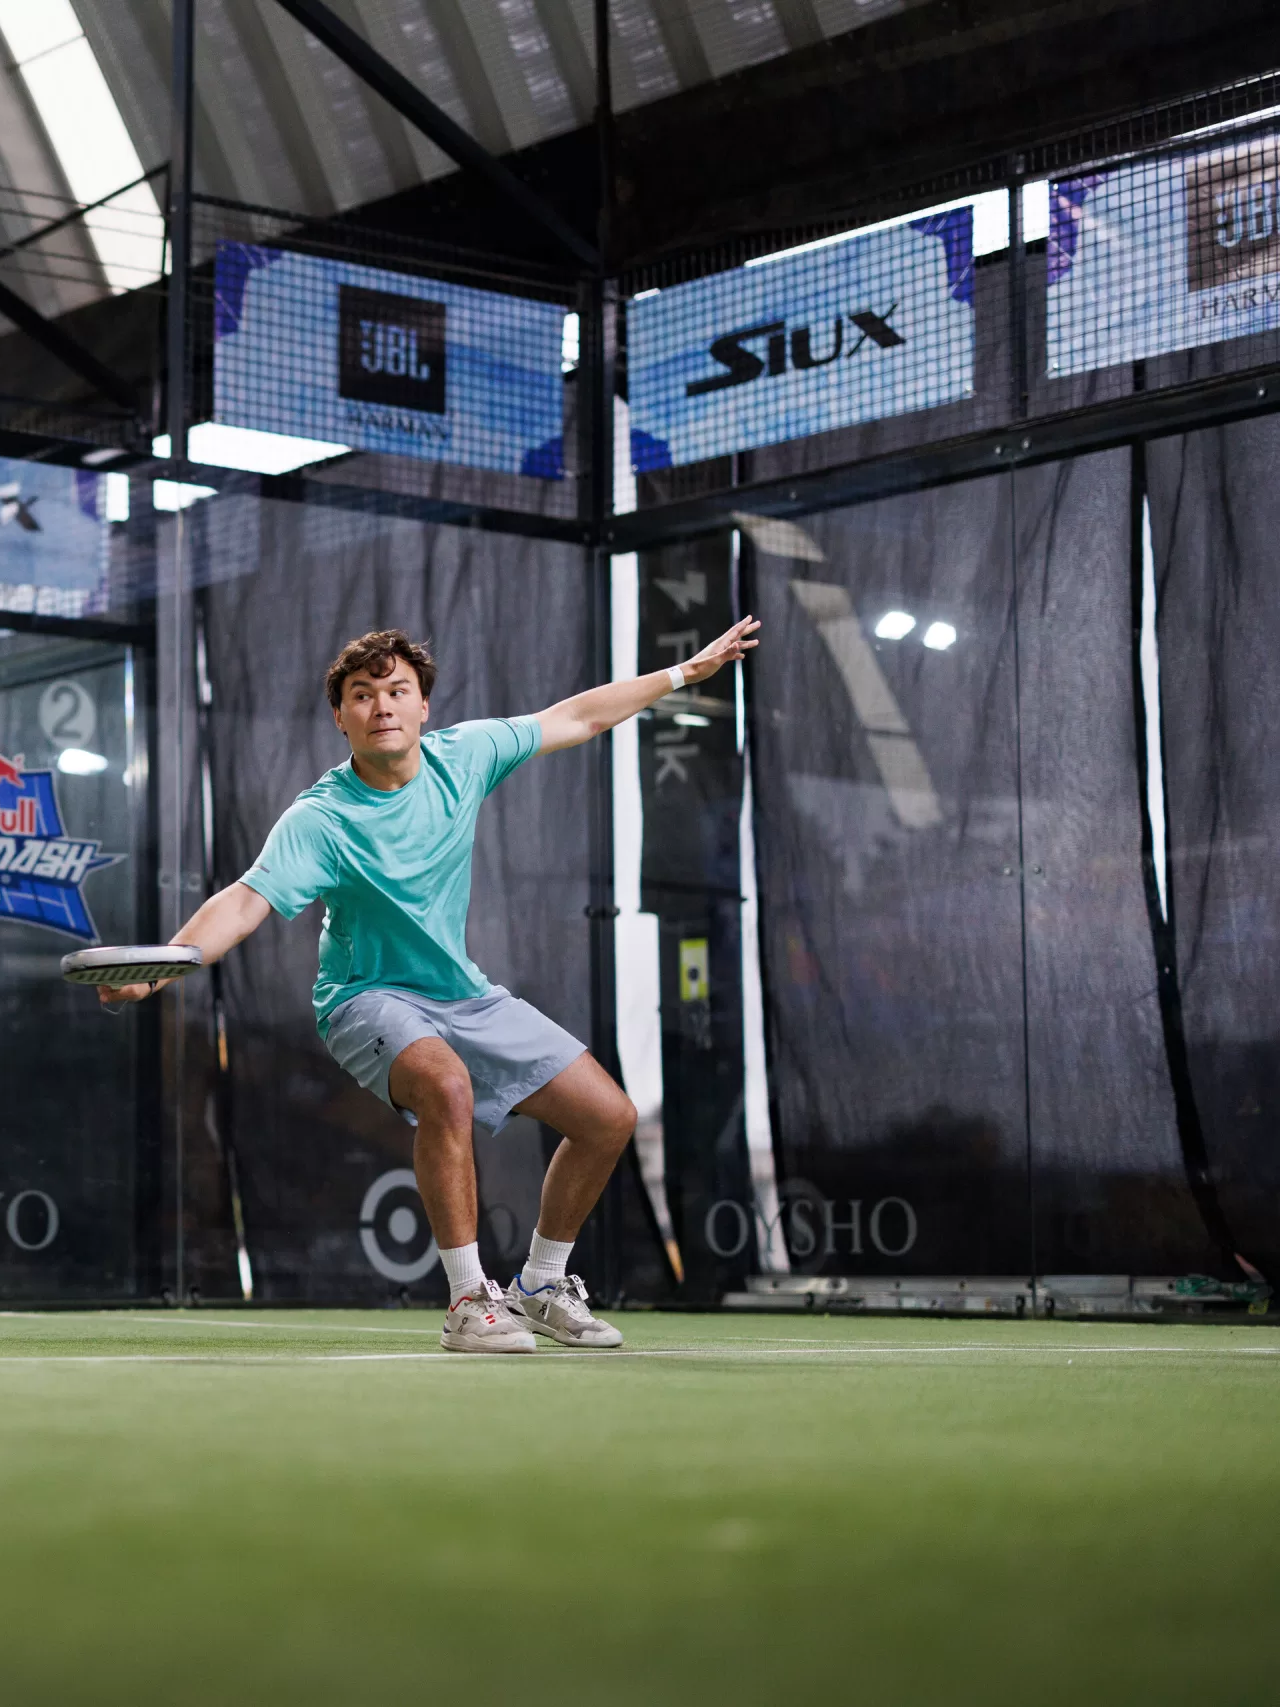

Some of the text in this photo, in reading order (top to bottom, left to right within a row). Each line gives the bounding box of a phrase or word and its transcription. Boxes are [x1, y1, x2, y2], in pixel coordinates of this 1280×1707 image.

[1216, 182, 1280, 248] JB
[360, 319, 429, 381] JBL
[51, 685, 83, 739] 2
[705, 1197, 918, 1257] OYSHO
